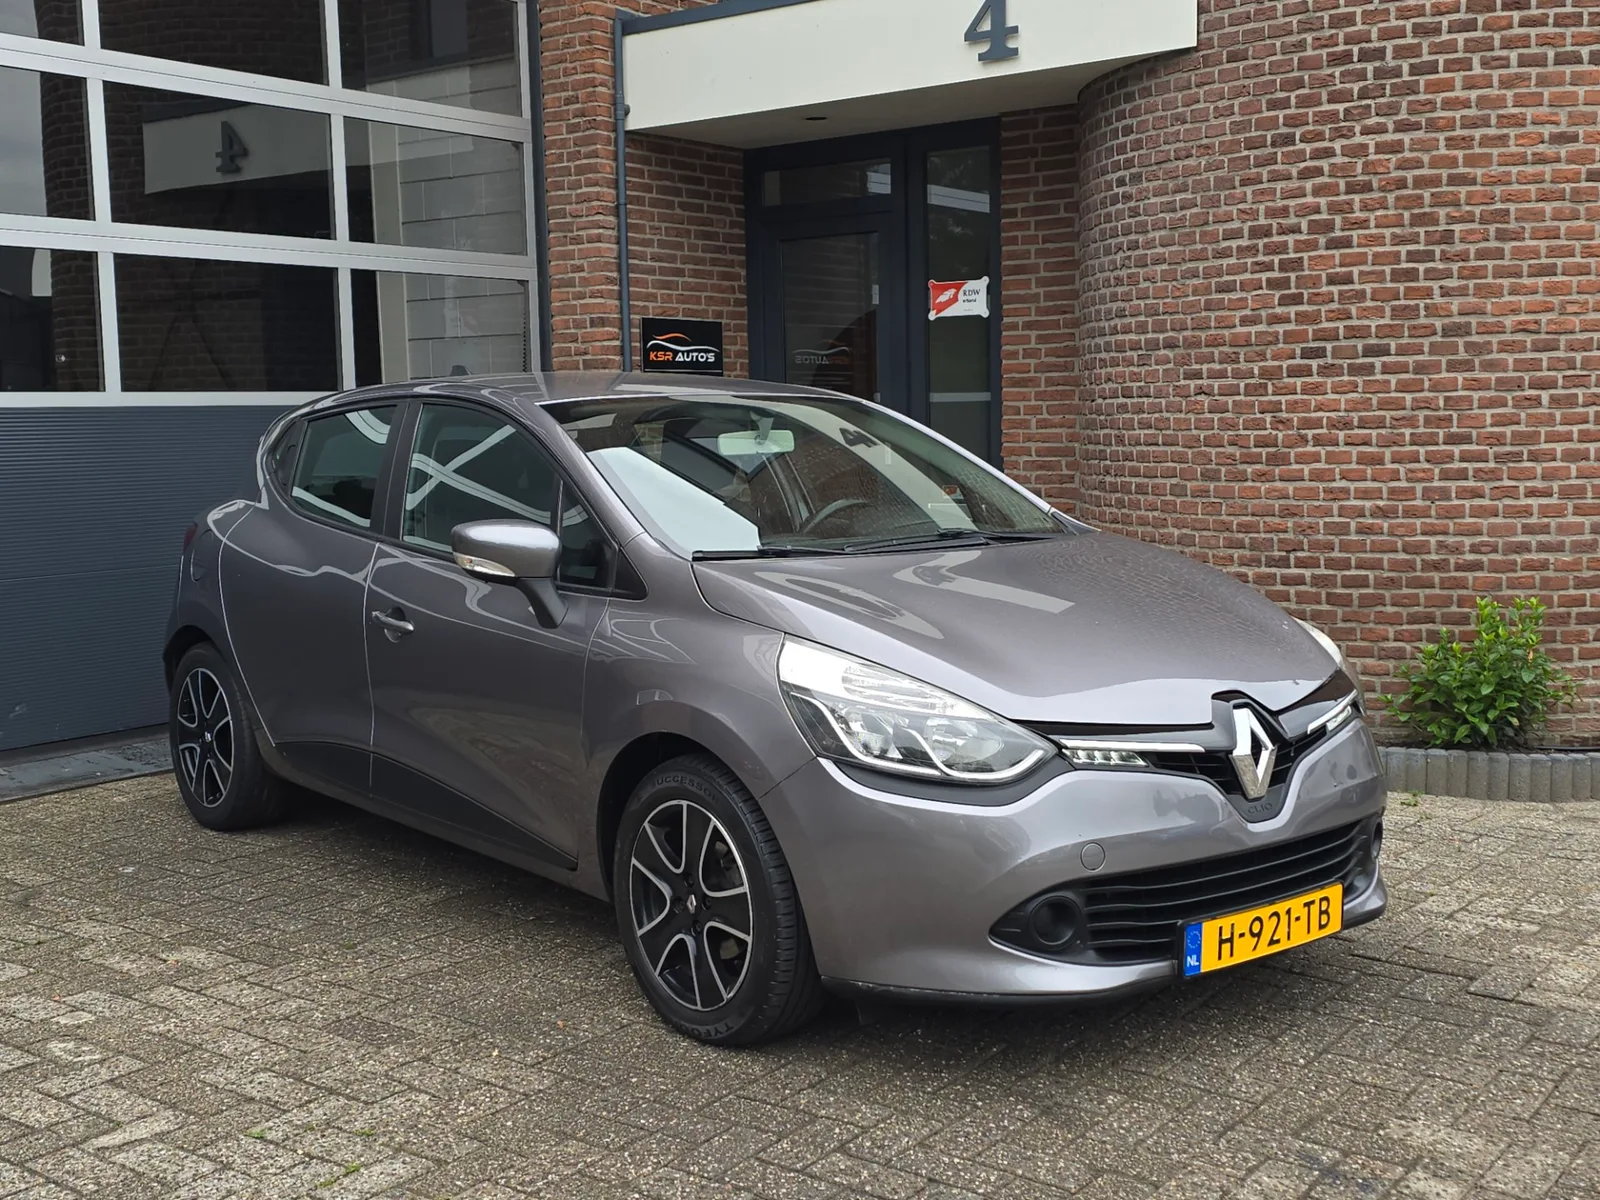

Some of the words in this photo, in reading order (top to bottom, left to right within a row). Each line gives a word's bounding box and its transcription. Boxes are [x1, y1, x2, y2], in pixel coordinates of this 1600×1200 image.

[964, 0, 1019, 61] 4
[963, 289, 981, 297] RDW
[649, 351, 673, 361] KSR
[675, 352, 715, 362] AUTO'S
[652, 774, 719, 803] UCCESSO
[1248, 802, 1273, 814] CLIO
[1217, 896, 1331, 961] H-921-TB
[1186, 955, 1200, 968] NL
[675, 1021, 735, 1038] TYFOO
